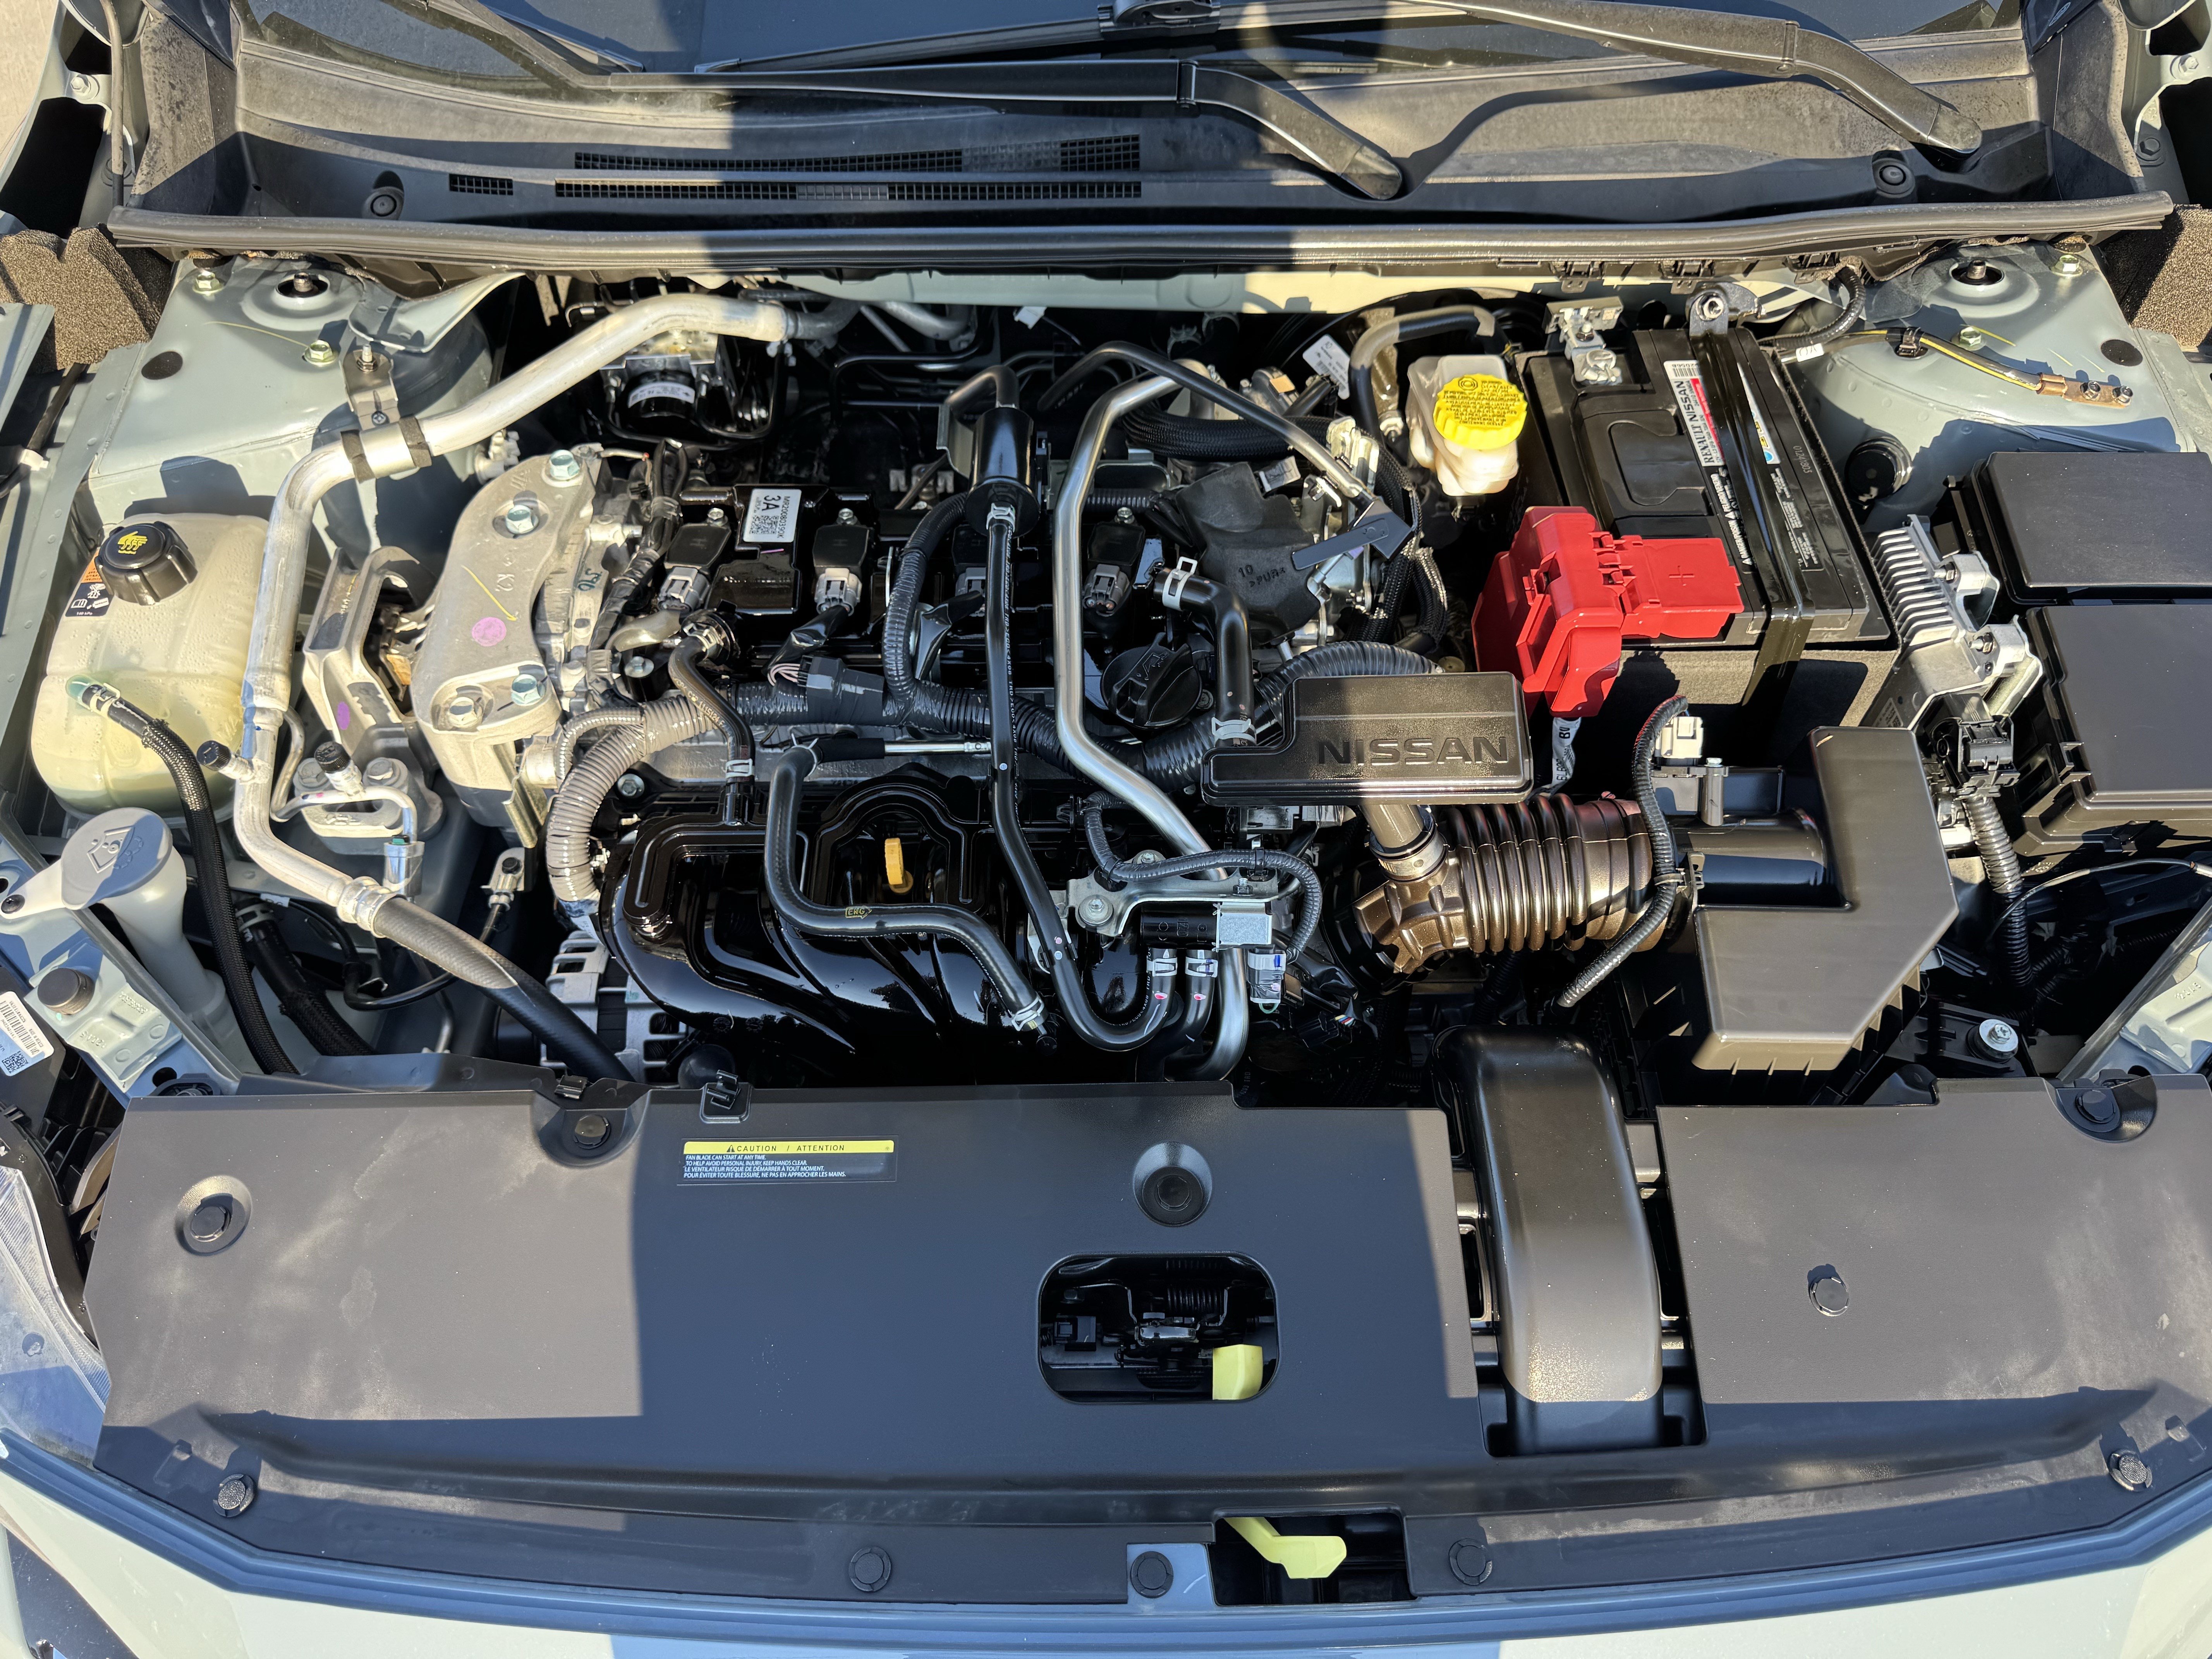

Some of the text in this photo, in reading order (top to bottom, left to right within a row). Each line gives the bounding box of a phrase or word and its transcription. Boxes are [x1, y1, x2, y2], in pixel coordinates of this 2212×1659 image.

[1674, 381, 1698, 421] NISSAN
[1690, 425, 1714, 463] RENAULT
[761, 495, 781, 512] 3A
[1238, 564, 1253, 577] 10
[1318, 737, 1508, 766] NISSAN
